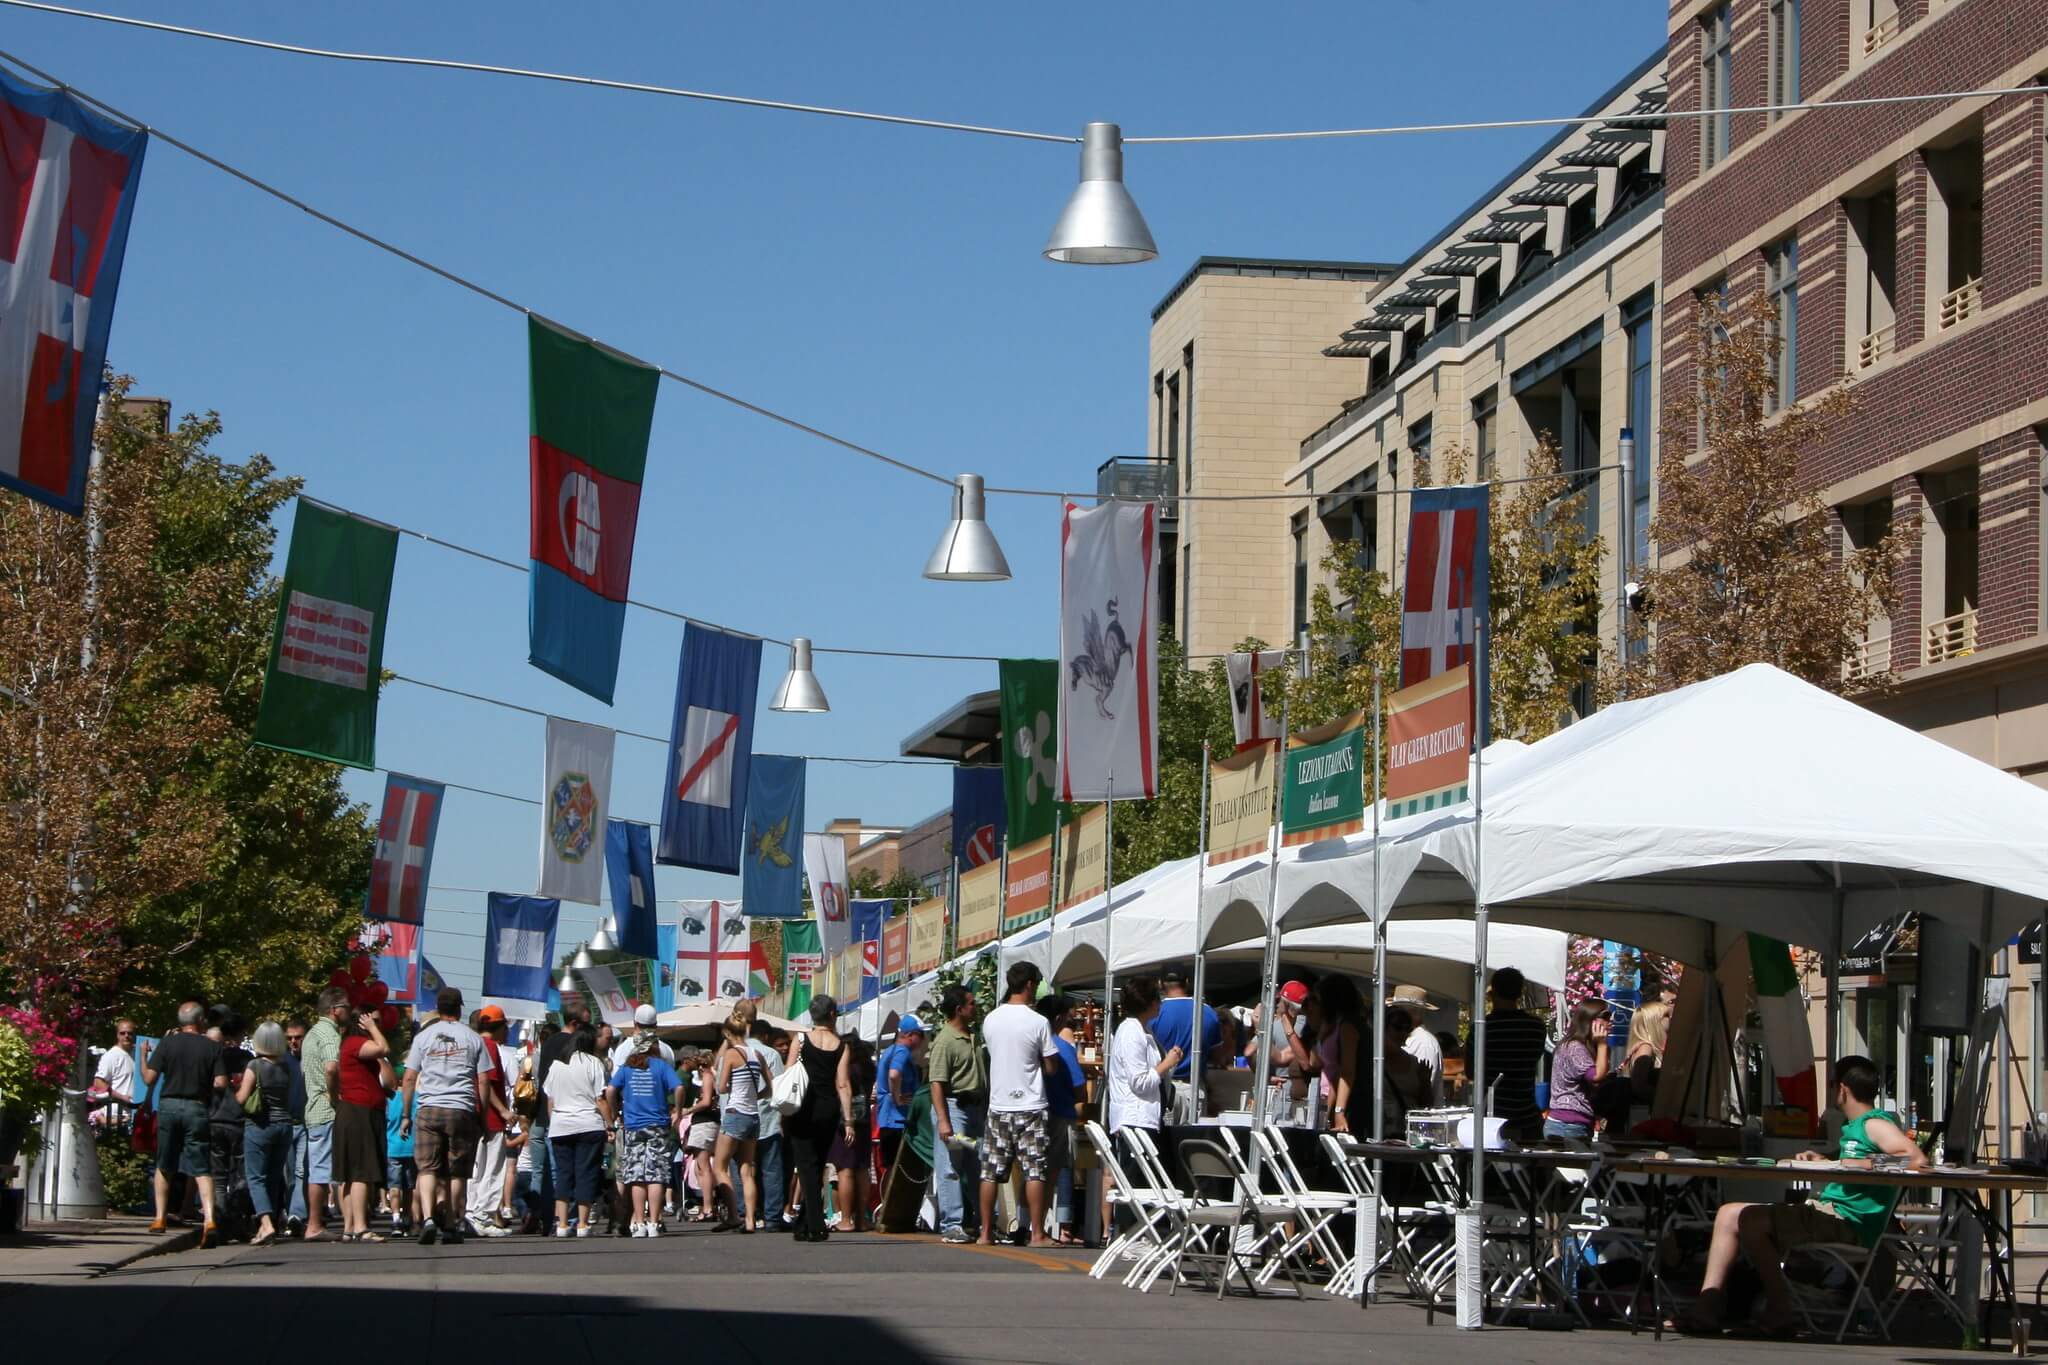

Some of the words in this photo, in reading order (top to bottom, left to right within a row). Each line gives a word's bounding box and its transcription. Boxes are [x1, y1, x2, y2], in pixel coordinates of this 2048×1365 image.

[1391, 743, 1407, 769] PLAY
[1408, 736, 1428, 764] GREEN
[1429, 722, 1465, 759] RECYCLING
[1298, 756, 1325, 785] LEZIONI
[1214, 798, 1237, 826] ITALIAN
[1237, 786, 1268, 819] INSTITUTE
